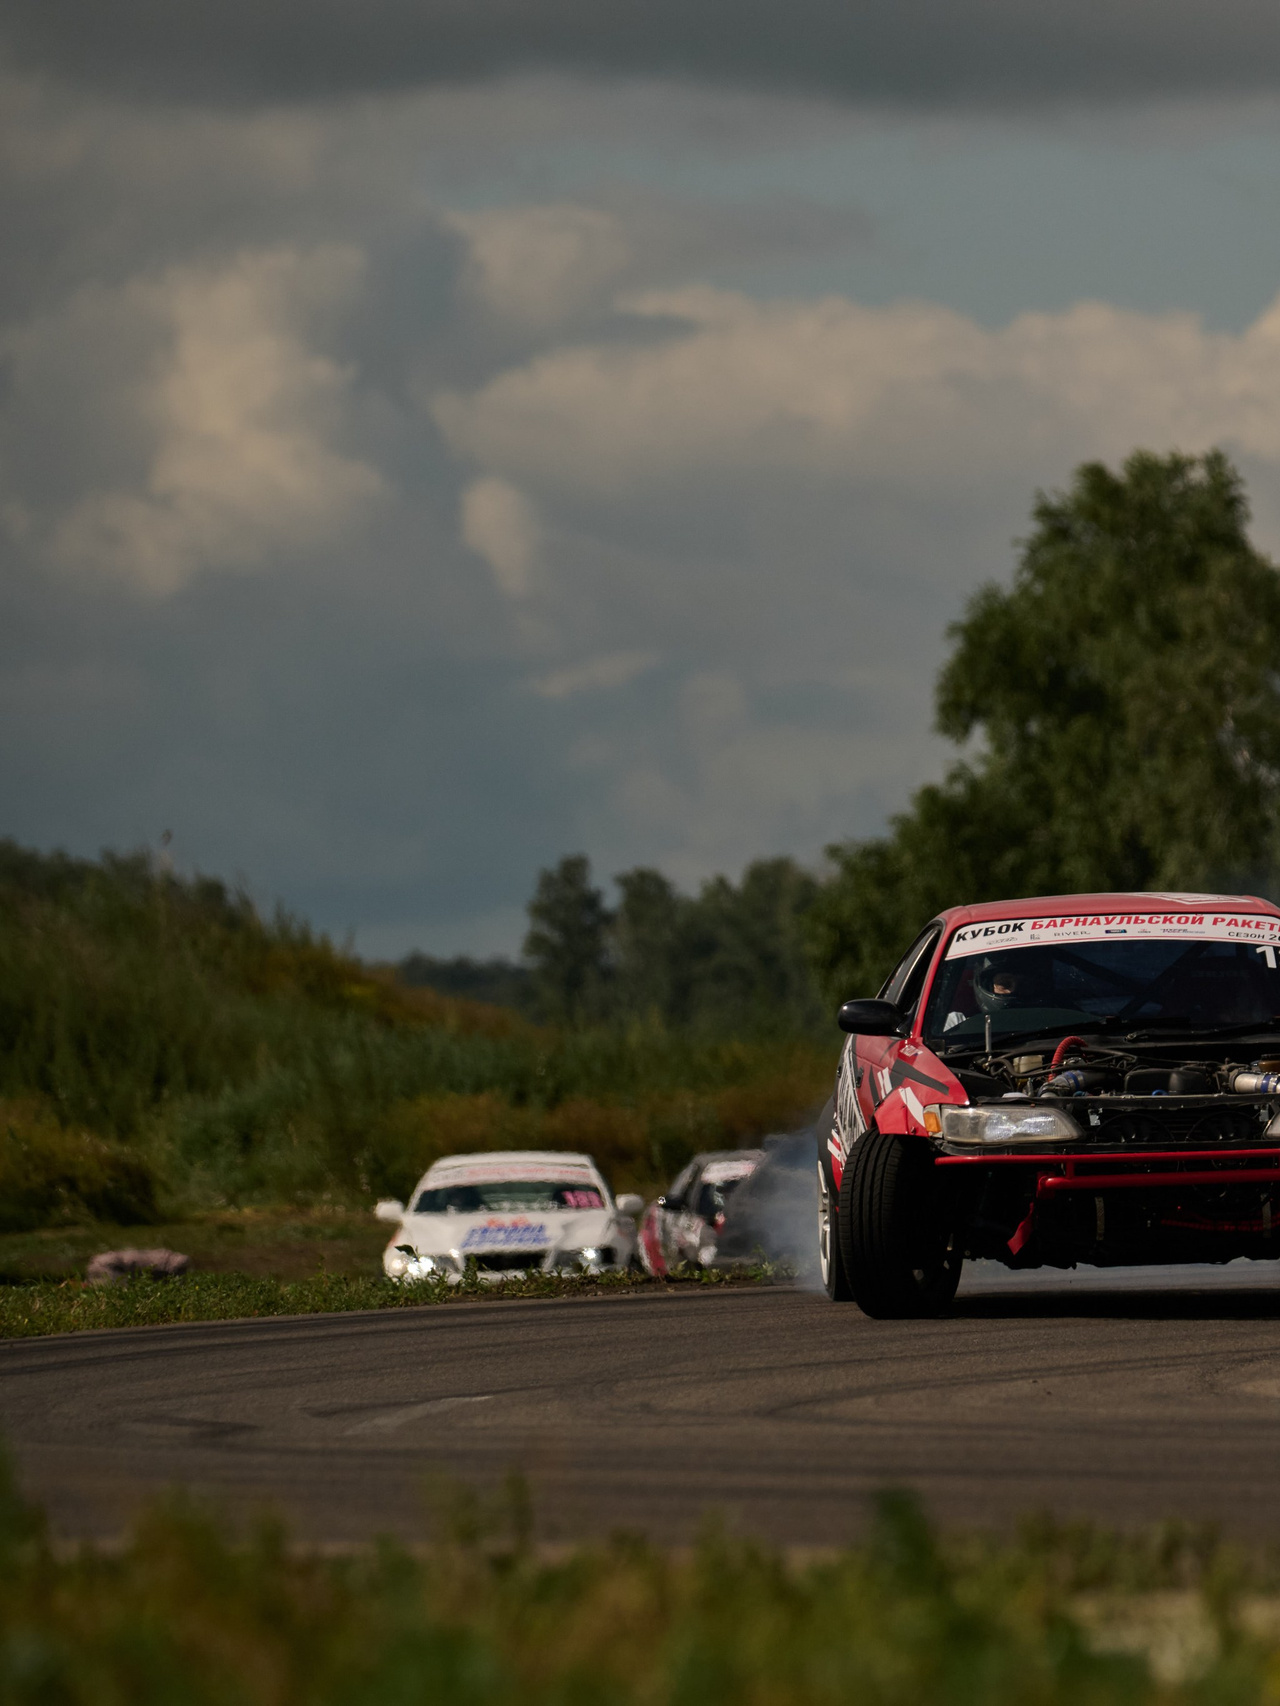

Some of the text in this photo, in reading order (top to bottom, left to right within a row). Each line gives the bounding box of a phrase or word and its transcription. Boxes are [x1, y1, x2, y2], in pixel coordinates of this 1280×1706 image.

[955, 922, 1026, 943] КУБОК
[1031, 914, 1204, 930] БАРНАУЛЬСКОЙ
[1228, 931, 1265, 940] СЕЗОН
